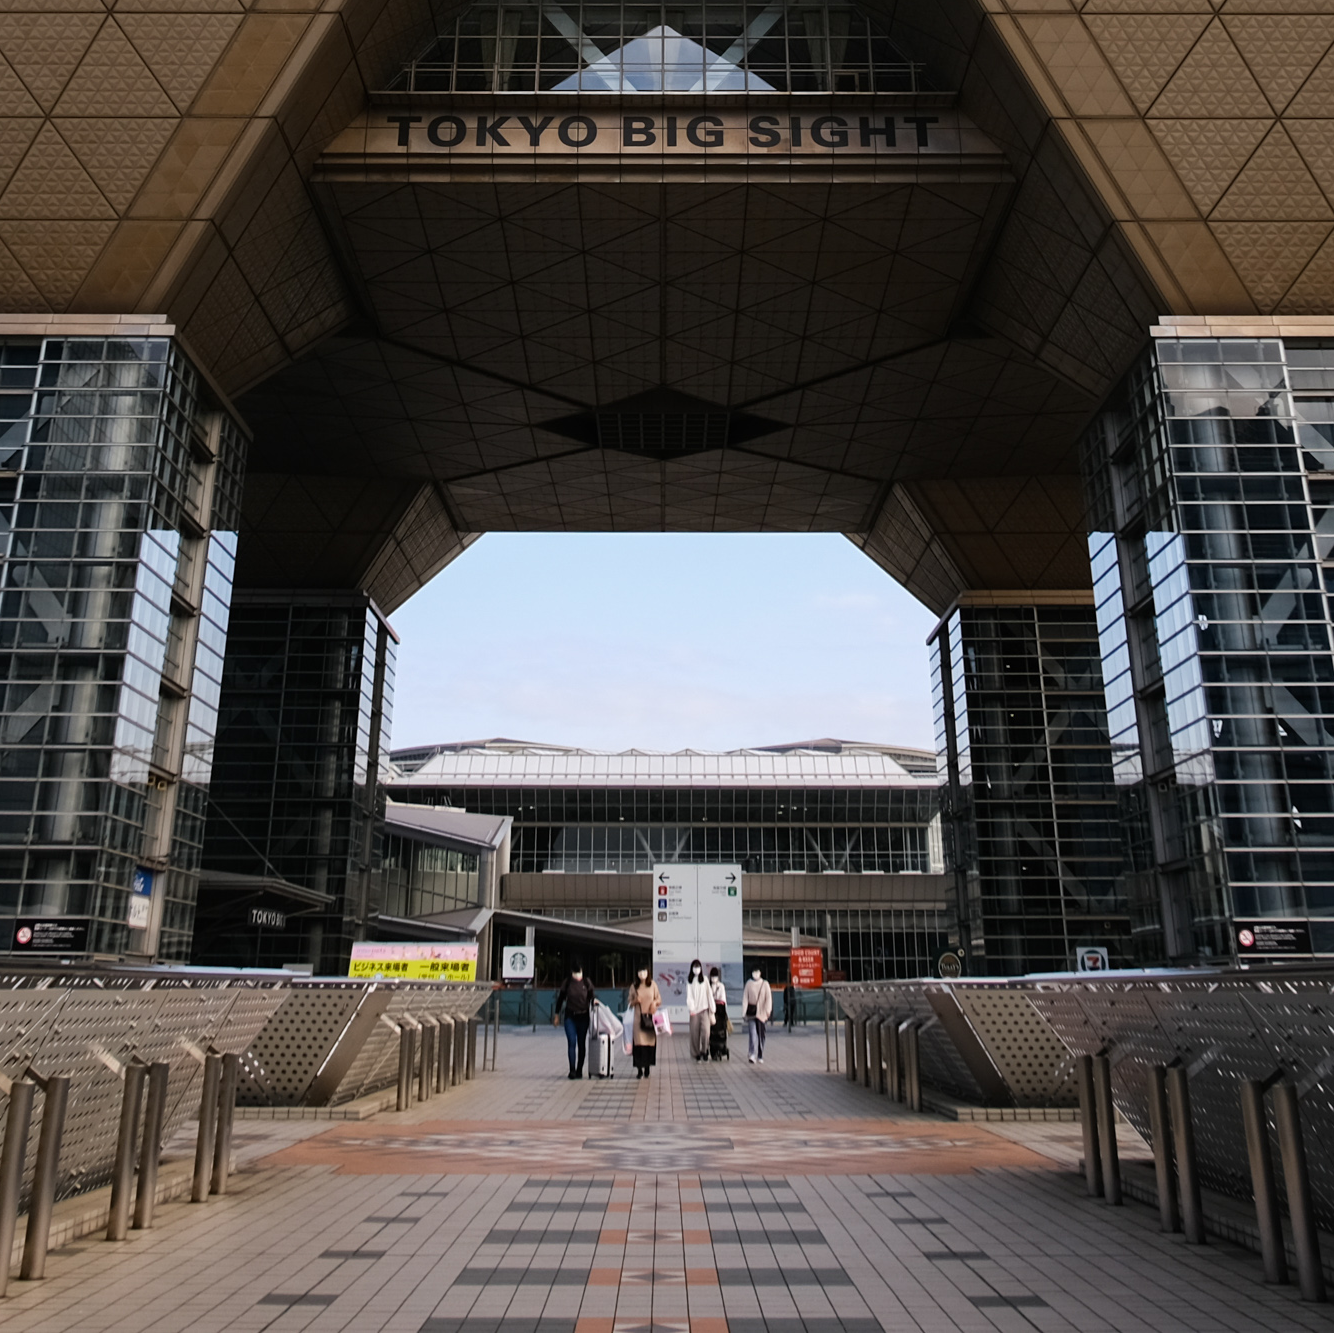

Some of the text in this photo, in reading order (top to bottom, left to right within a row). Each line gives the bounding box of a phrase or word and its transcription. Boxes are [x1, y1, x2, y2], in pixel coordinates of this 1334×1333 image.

[387, 115, 939, 148] TOKYO BIG SIGHT
[252, 909, 276, 926] TOKYO
[354, 962, 408, 972] ビジネス来場者
[419, 962, 470, 972] 一般来場者
